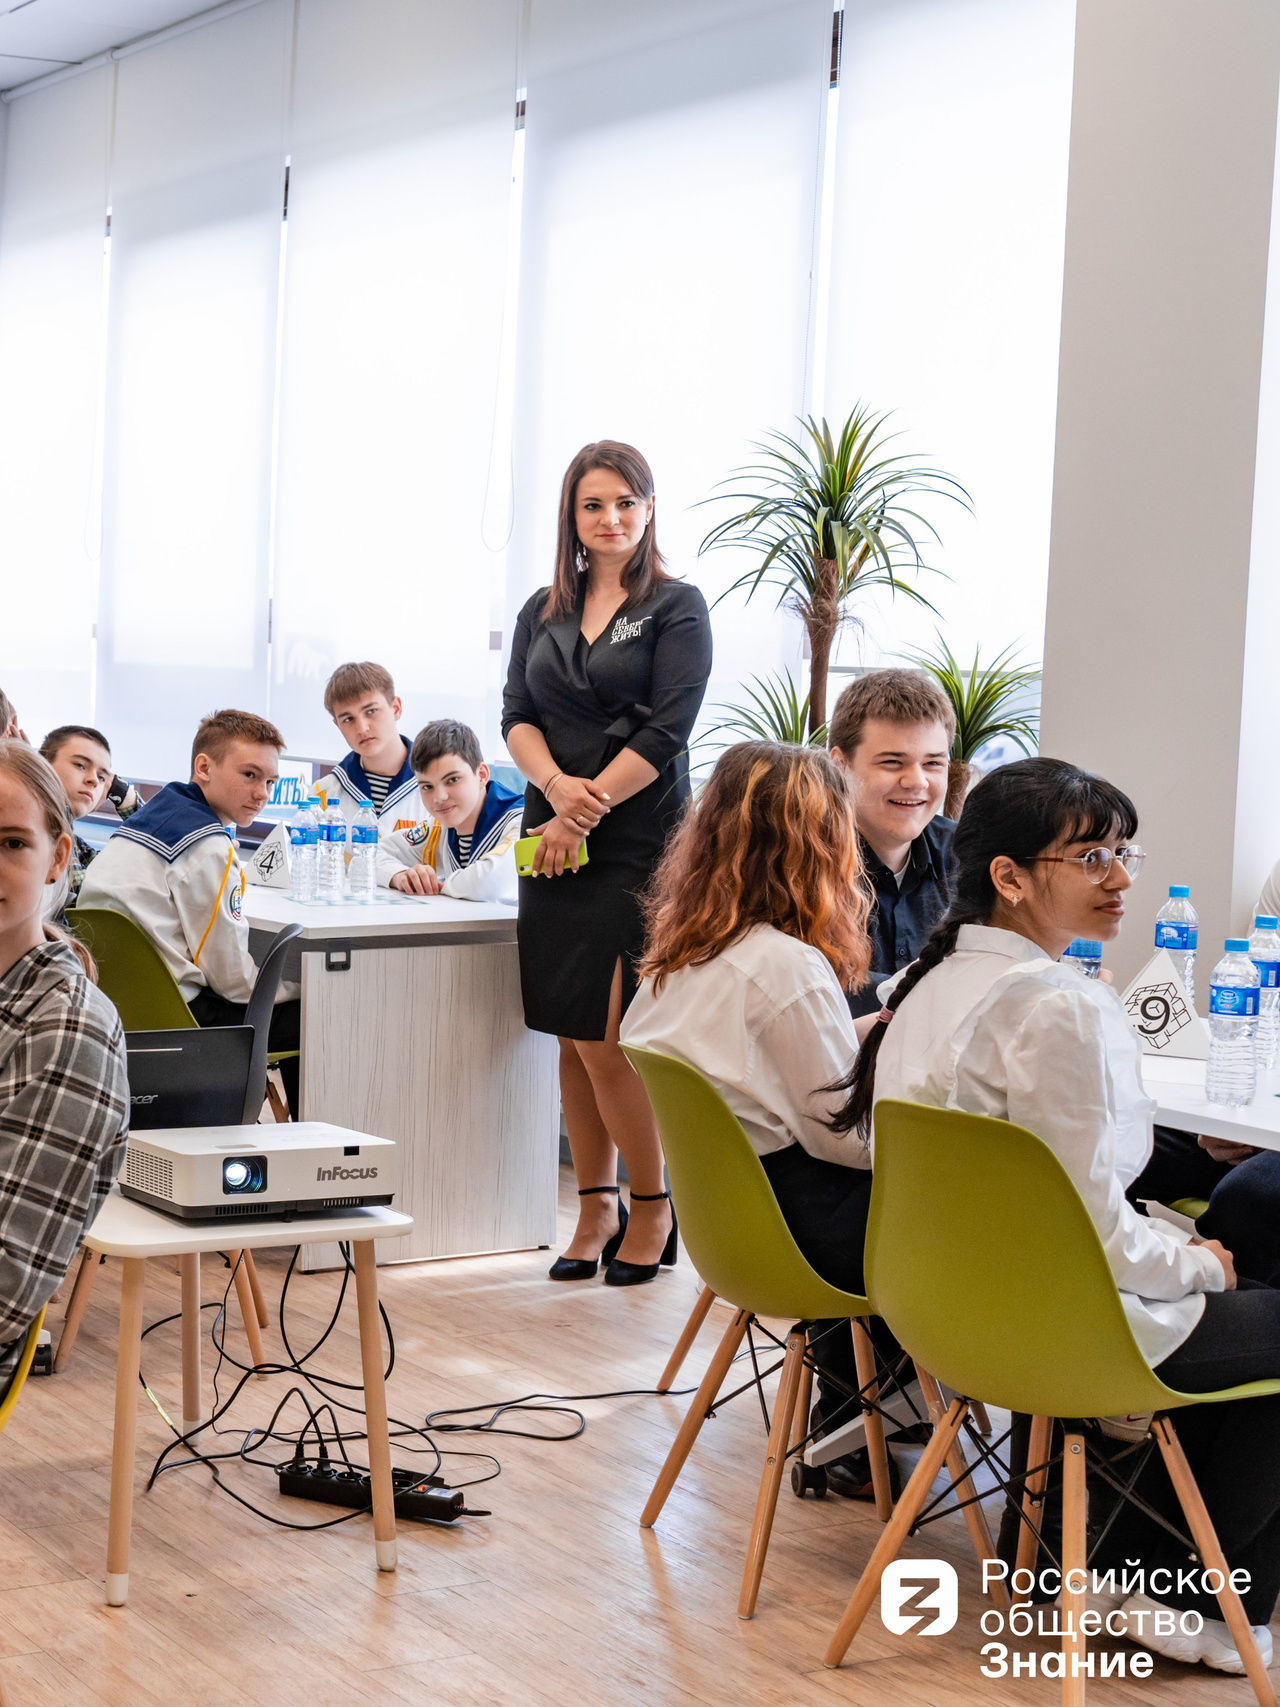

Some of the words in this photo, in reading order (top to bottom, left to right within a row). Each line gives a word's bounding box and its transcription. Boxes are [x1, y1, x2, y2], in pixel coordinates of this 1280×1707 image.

[268, 777, 302, 805] ИТЬ
[259, 850, 276, 874] 4
[1137, 995, 1171, 1035] 9
[316, 1166, 378, 1181] InFocus
